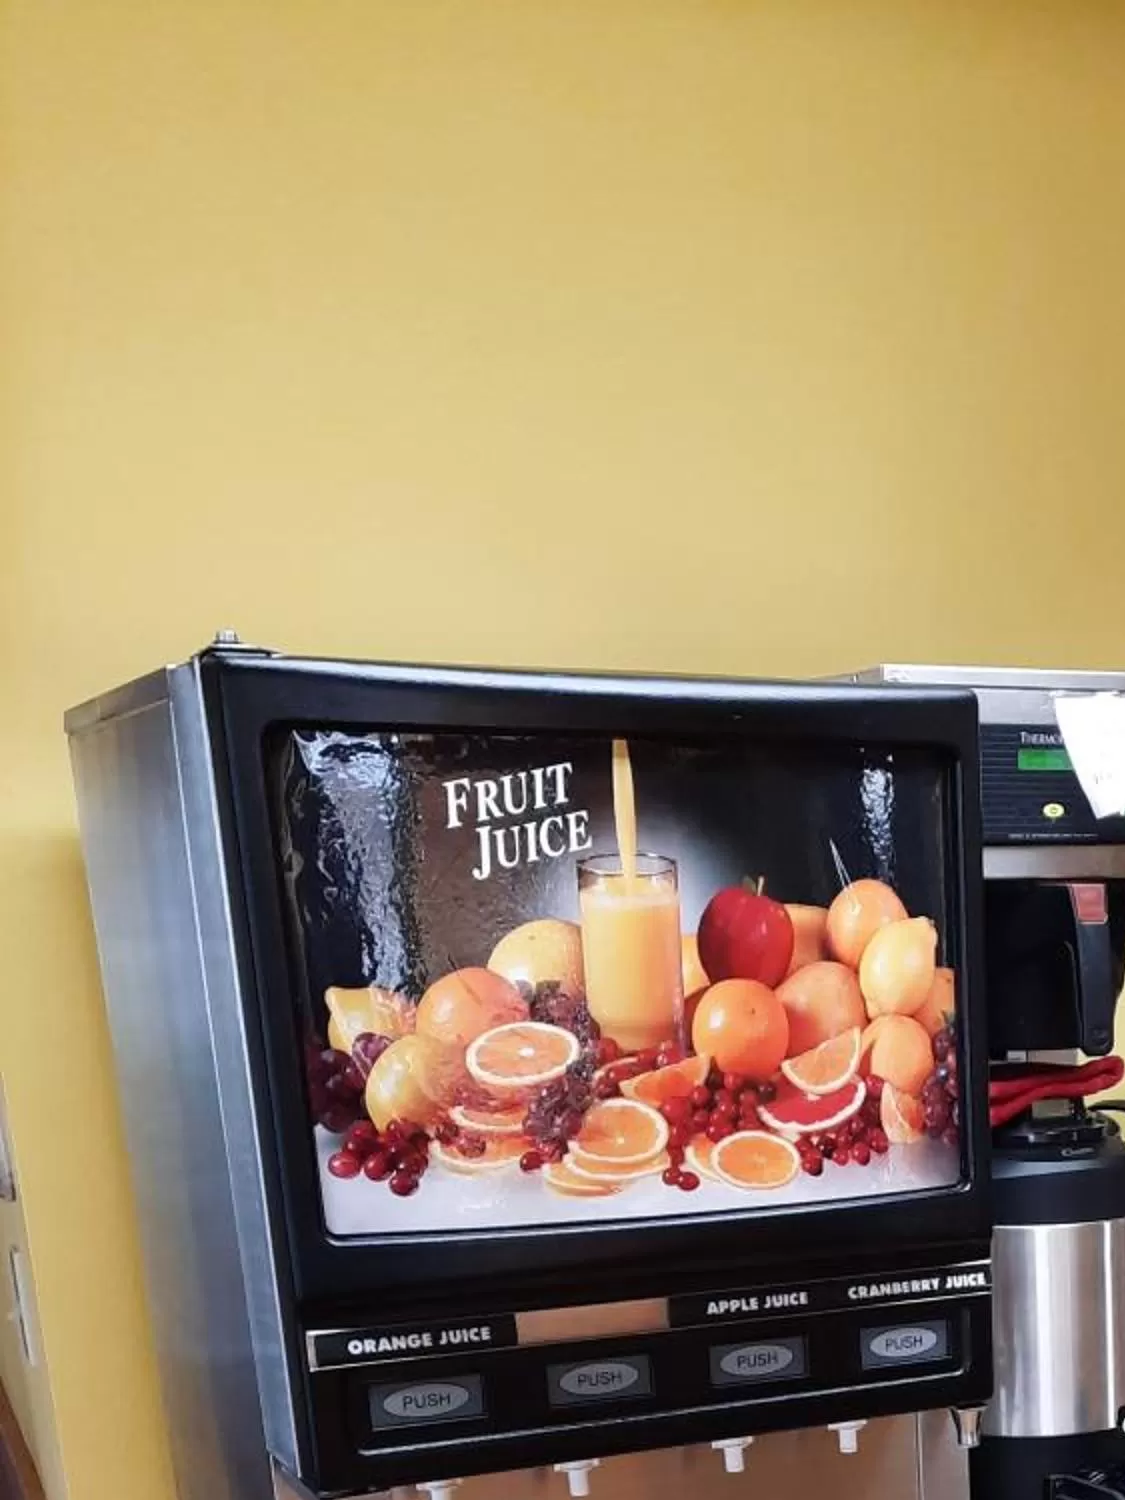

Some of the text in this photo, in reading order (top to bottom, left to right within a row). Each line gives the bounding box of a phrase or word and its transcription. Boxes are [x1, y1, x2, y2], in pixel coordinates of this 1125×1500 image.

[443, 762, 573, 829] FRUIT
[472, 810, 593, 881] JUICE
[847, 1271, 986, 1300] CRANBERRY JUICE
[706, 1291, 809, 1315] APPLE JUICE
[347, 1325, 492, 1355] ORANGE JUICE
[884, 1335, 924, 1351] PUSH
[736, 1352, 779, 1368] PUSH
[577, 1371, 623, 1387] PUSH
[402, 1393, 452, 1411] PUSH
